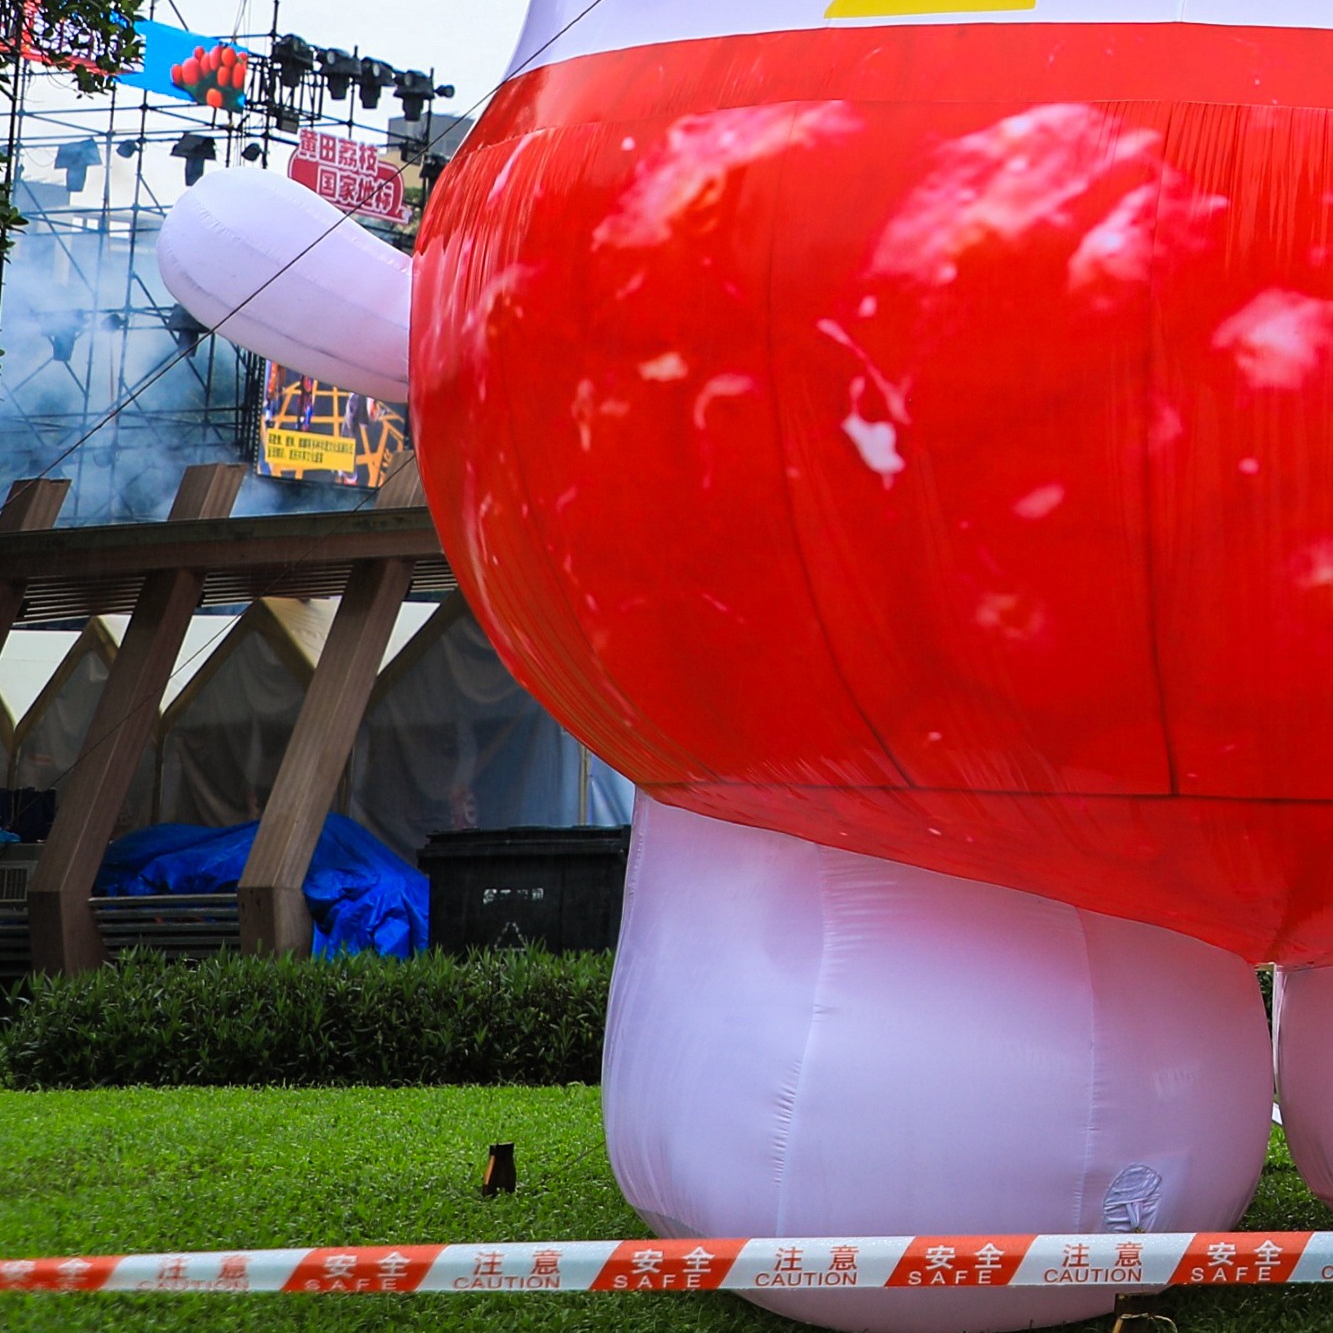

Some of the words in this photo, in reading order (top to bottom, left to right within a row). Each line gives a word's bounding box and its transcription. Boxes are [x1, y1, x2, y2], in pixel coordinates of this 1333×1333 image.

[299, 127, 379, 176] 黄田荔枝
[323, 1252, 411, 1278] 安全
[472, 1248, 563, 1276] 注意
[632, 1245, 715, 1274] 安全
[774, 1244, 859, 1272] 注意
[925, 1242, 1005, 1270] 安全
[1061, 1240, 1143, 1268] 注意
[1207, 1239, 1283, 1266] 安全
[305, 1278, 397, 1290] SAFE
[453, 1276, 560, 1291] CAUTION
[613, 1275, 701, 1289] SAFE
[755, 1271, 858, 1287] CAUTION
[907, 1270, 992, 1285] SAFE
[1043, 1268, 1143, 1284] CAUTION
[1190, 1266, 1272, 1282] SAFE
